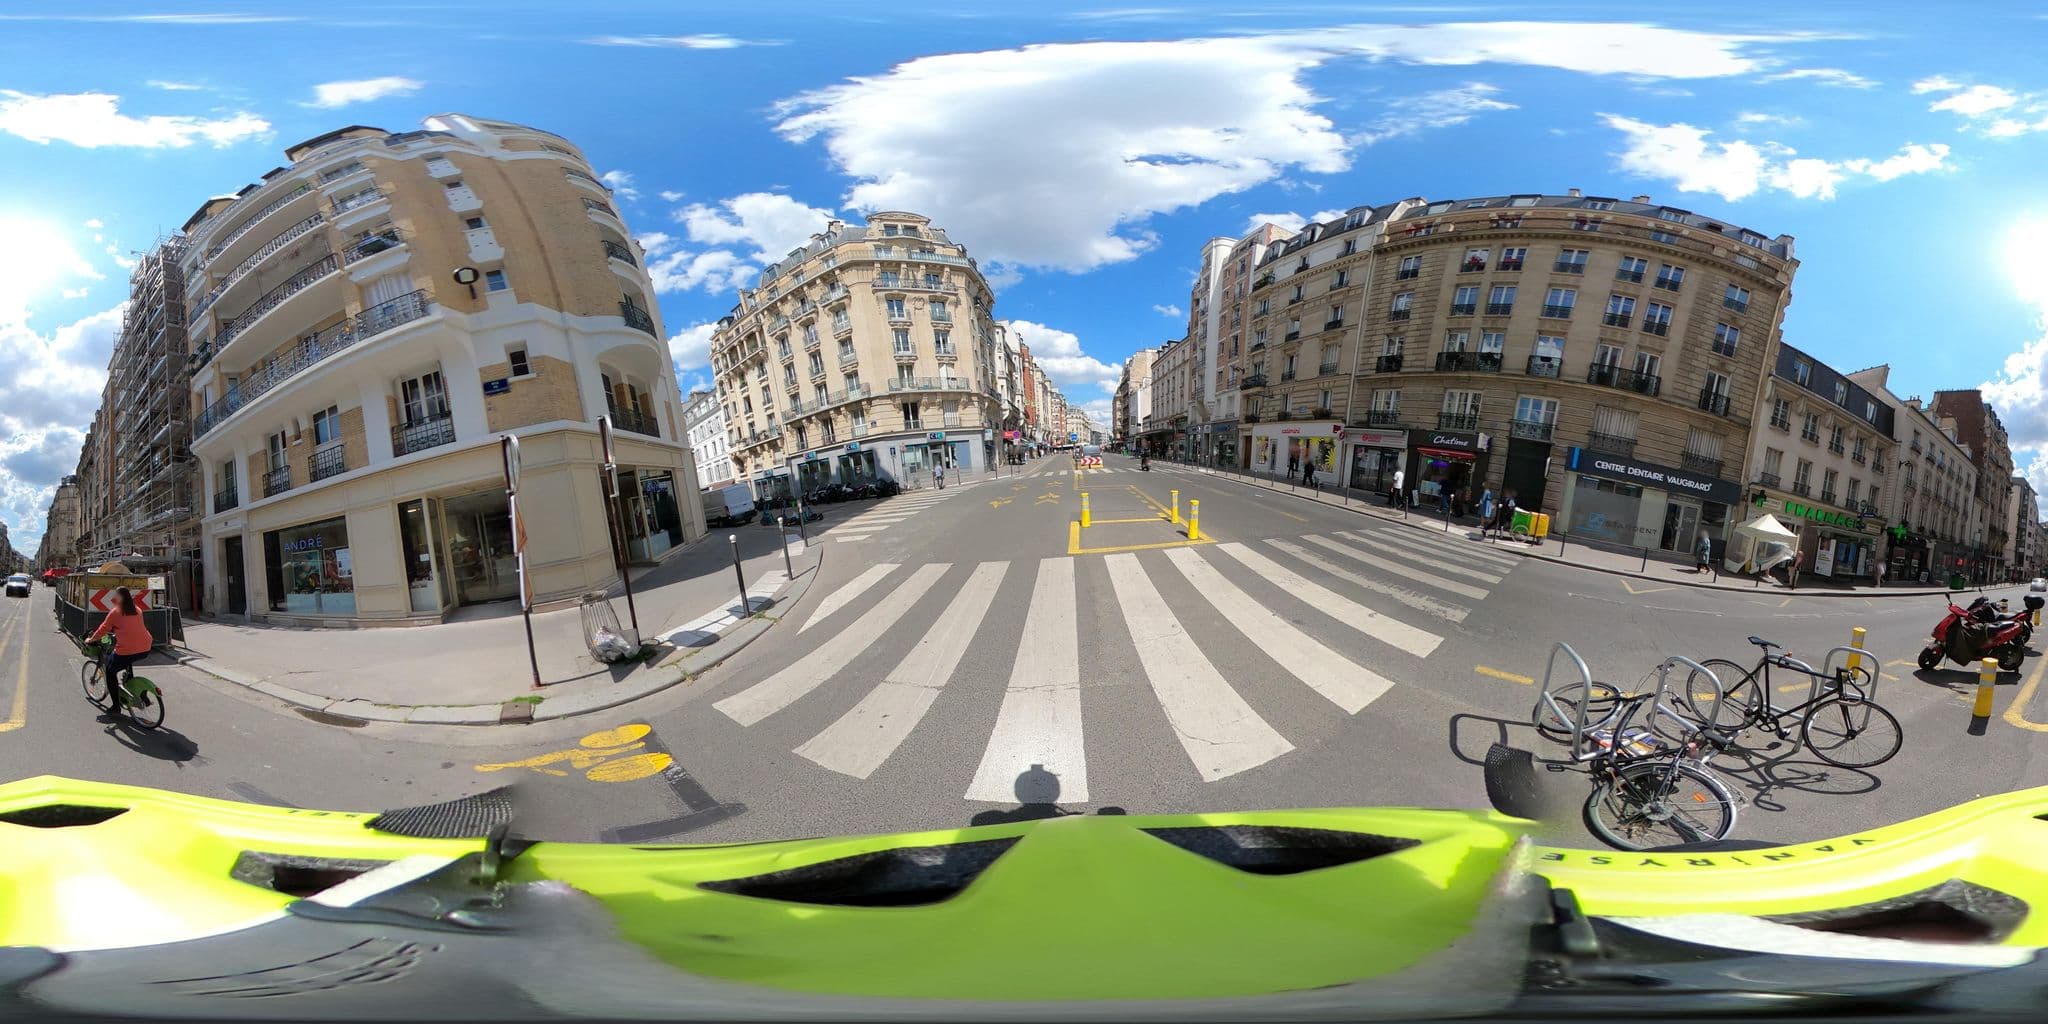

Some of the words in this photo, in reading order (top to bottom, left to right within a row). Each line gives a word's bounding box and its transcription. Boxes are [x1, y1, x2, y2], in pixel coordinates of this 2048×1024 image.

[1433, 435, 1469, 446] Chatime
[1594, 460, 1626, 474] CENTRE
[1627, 466, 1664, 482] DENTAIRE
[1785, 501, 1858, 529] PHARMACI
[284, 534, 322, 550] ANDRÉ
